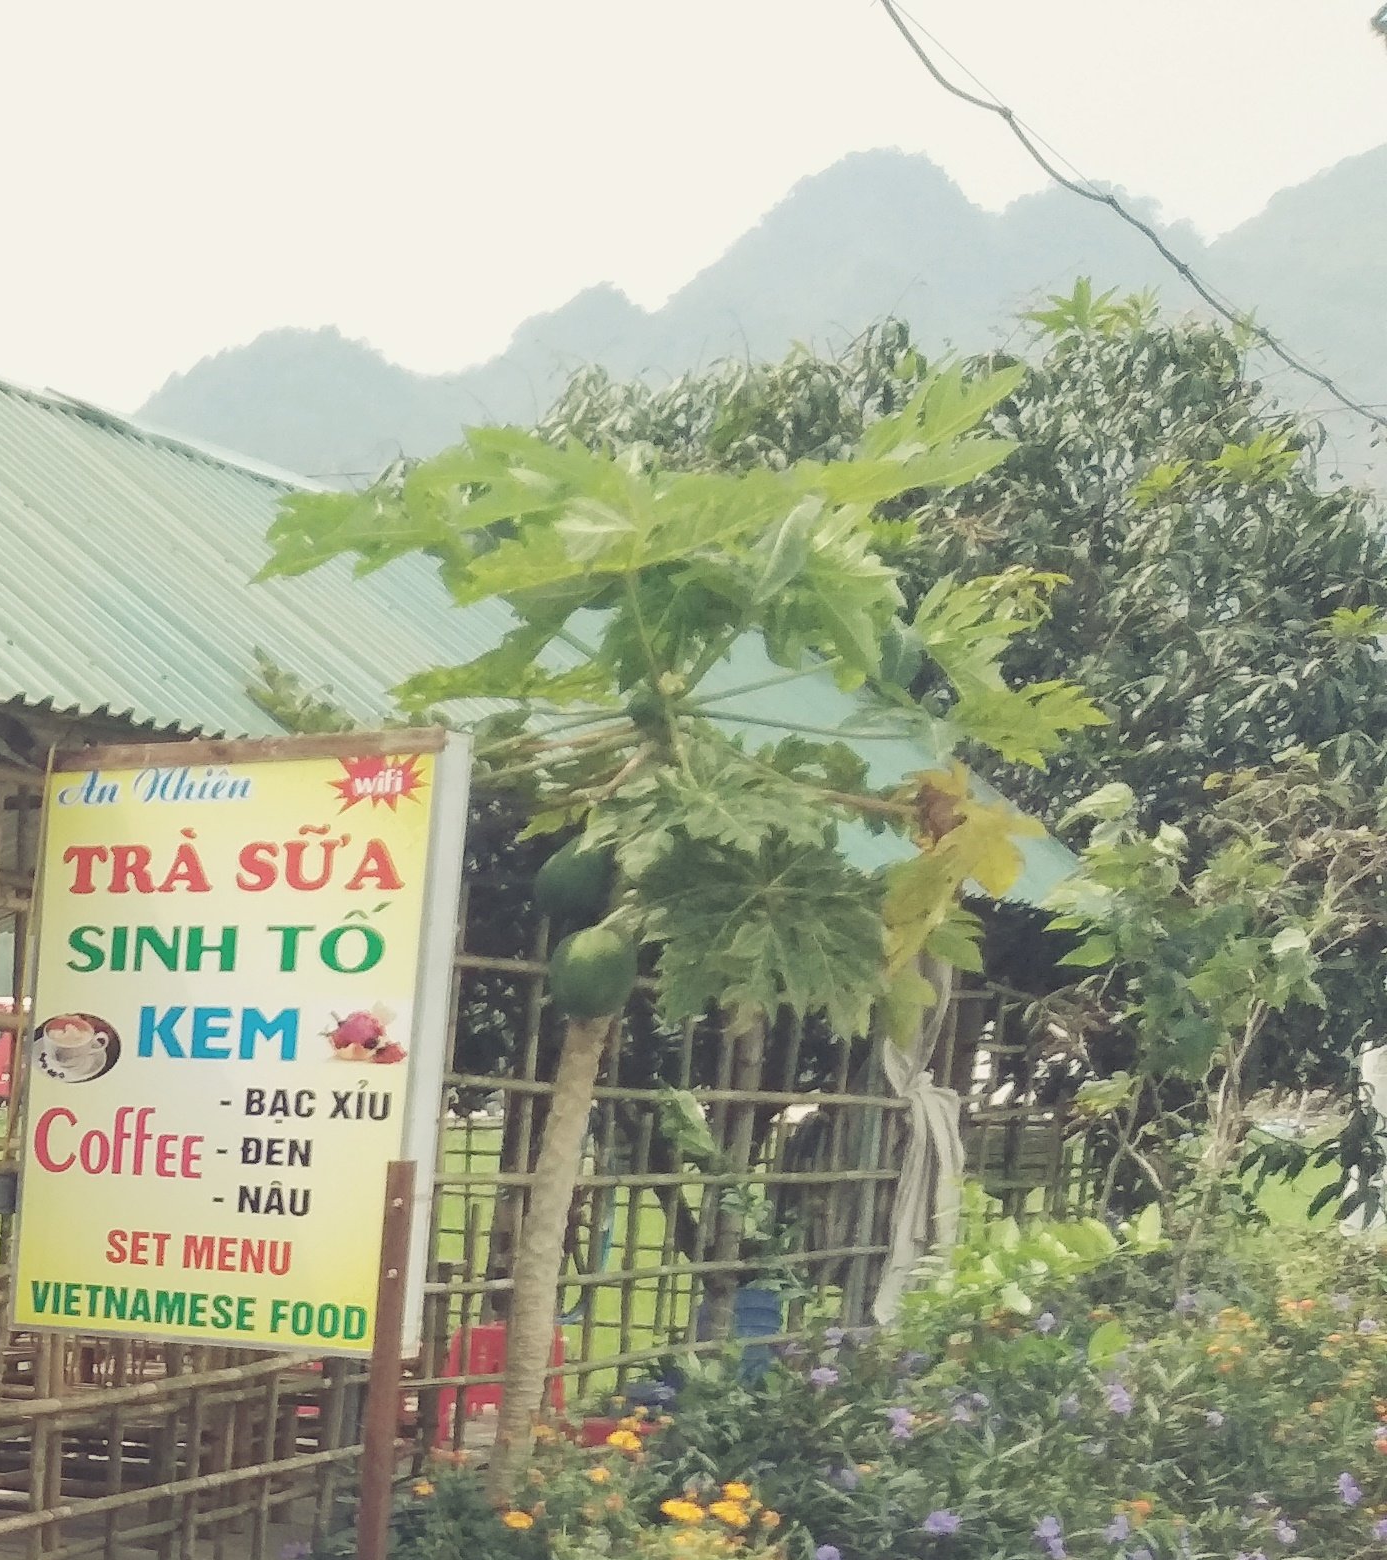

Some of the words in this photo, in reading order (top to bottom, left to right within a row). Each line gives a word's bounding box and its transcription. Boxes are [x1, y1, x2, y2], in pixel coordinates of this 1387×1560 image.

[58, 769, 119, 806] An
[134, 766, 253, 804] Nhiên
[353, 768, 405, 796] wifi
[63, 827, 214, 895] TRÀ
[235, 824, 407, 893] SỮA
[65, 924, 240, 974] SINH
[266, 901, 395, 974] TỐ
[138, 1005, 301, 1061] KEM
[244, 1087, 317, 1125] BẠC
[328, 1080, 393, 1122] XỈU
[240, 1136, 313, 1168] ĐEN
[236, 1180, 312, 1217] NÂU
[105, 1228, 172, 1268] SET
[181, 1235, 293, 1276] MENU
[31, 1280, 257, 1332] VIETNAMESE
[269, 1299, 369, 1341] FOOD
